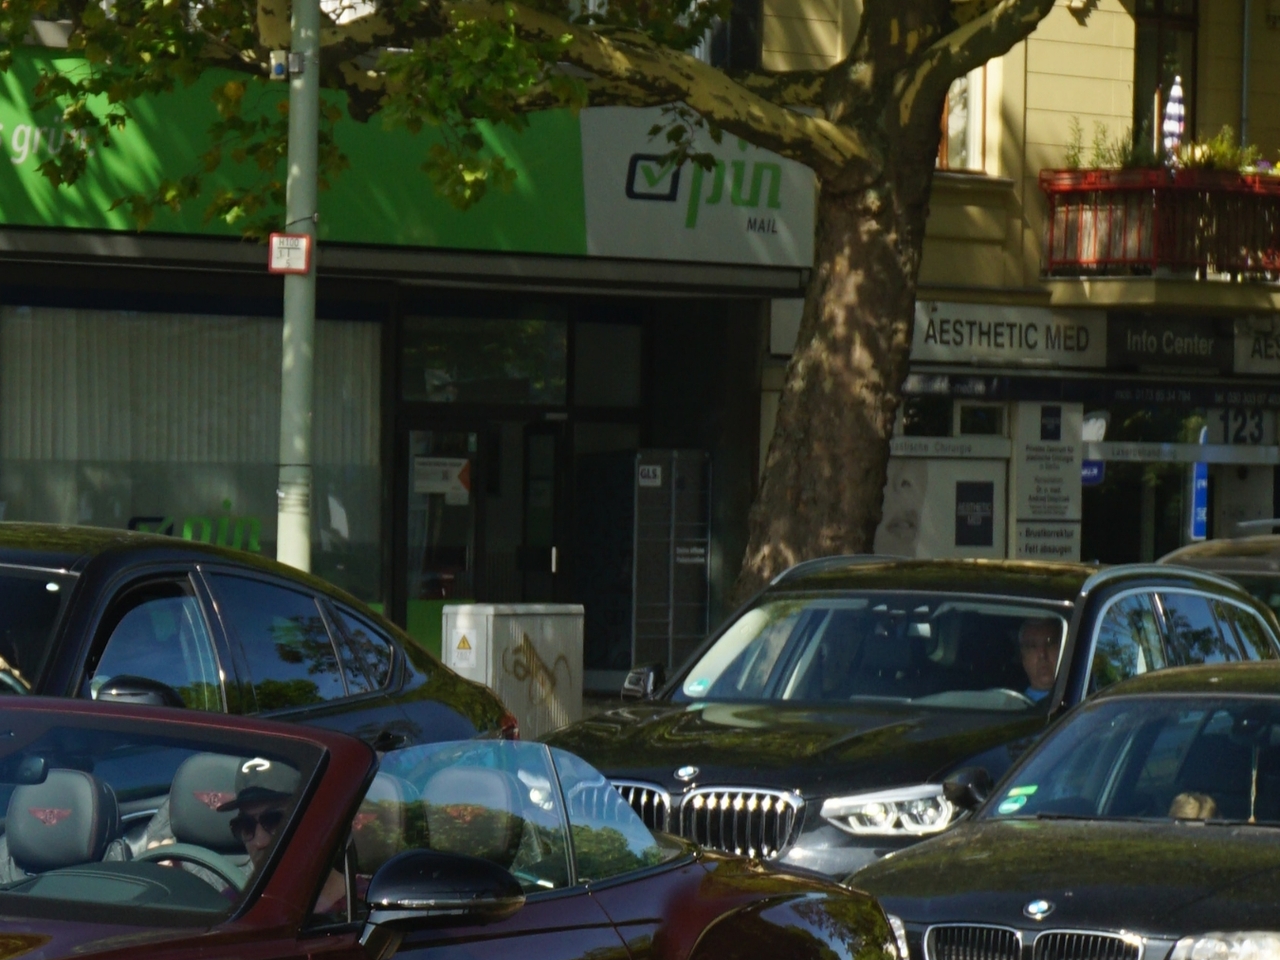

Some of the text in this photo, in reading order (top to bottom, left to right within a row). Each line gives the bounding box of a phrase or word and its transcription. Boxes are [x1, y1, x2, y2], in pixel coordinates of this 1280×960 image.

[685, 138, 782, 230] pin
[746, 216, 778, 234] MAIL
[923, 317, 1090, 352] AESTHETIC MED
[1126, 328, 1215, 356] Info Center
[1219, 407, 1264, 445] 123
